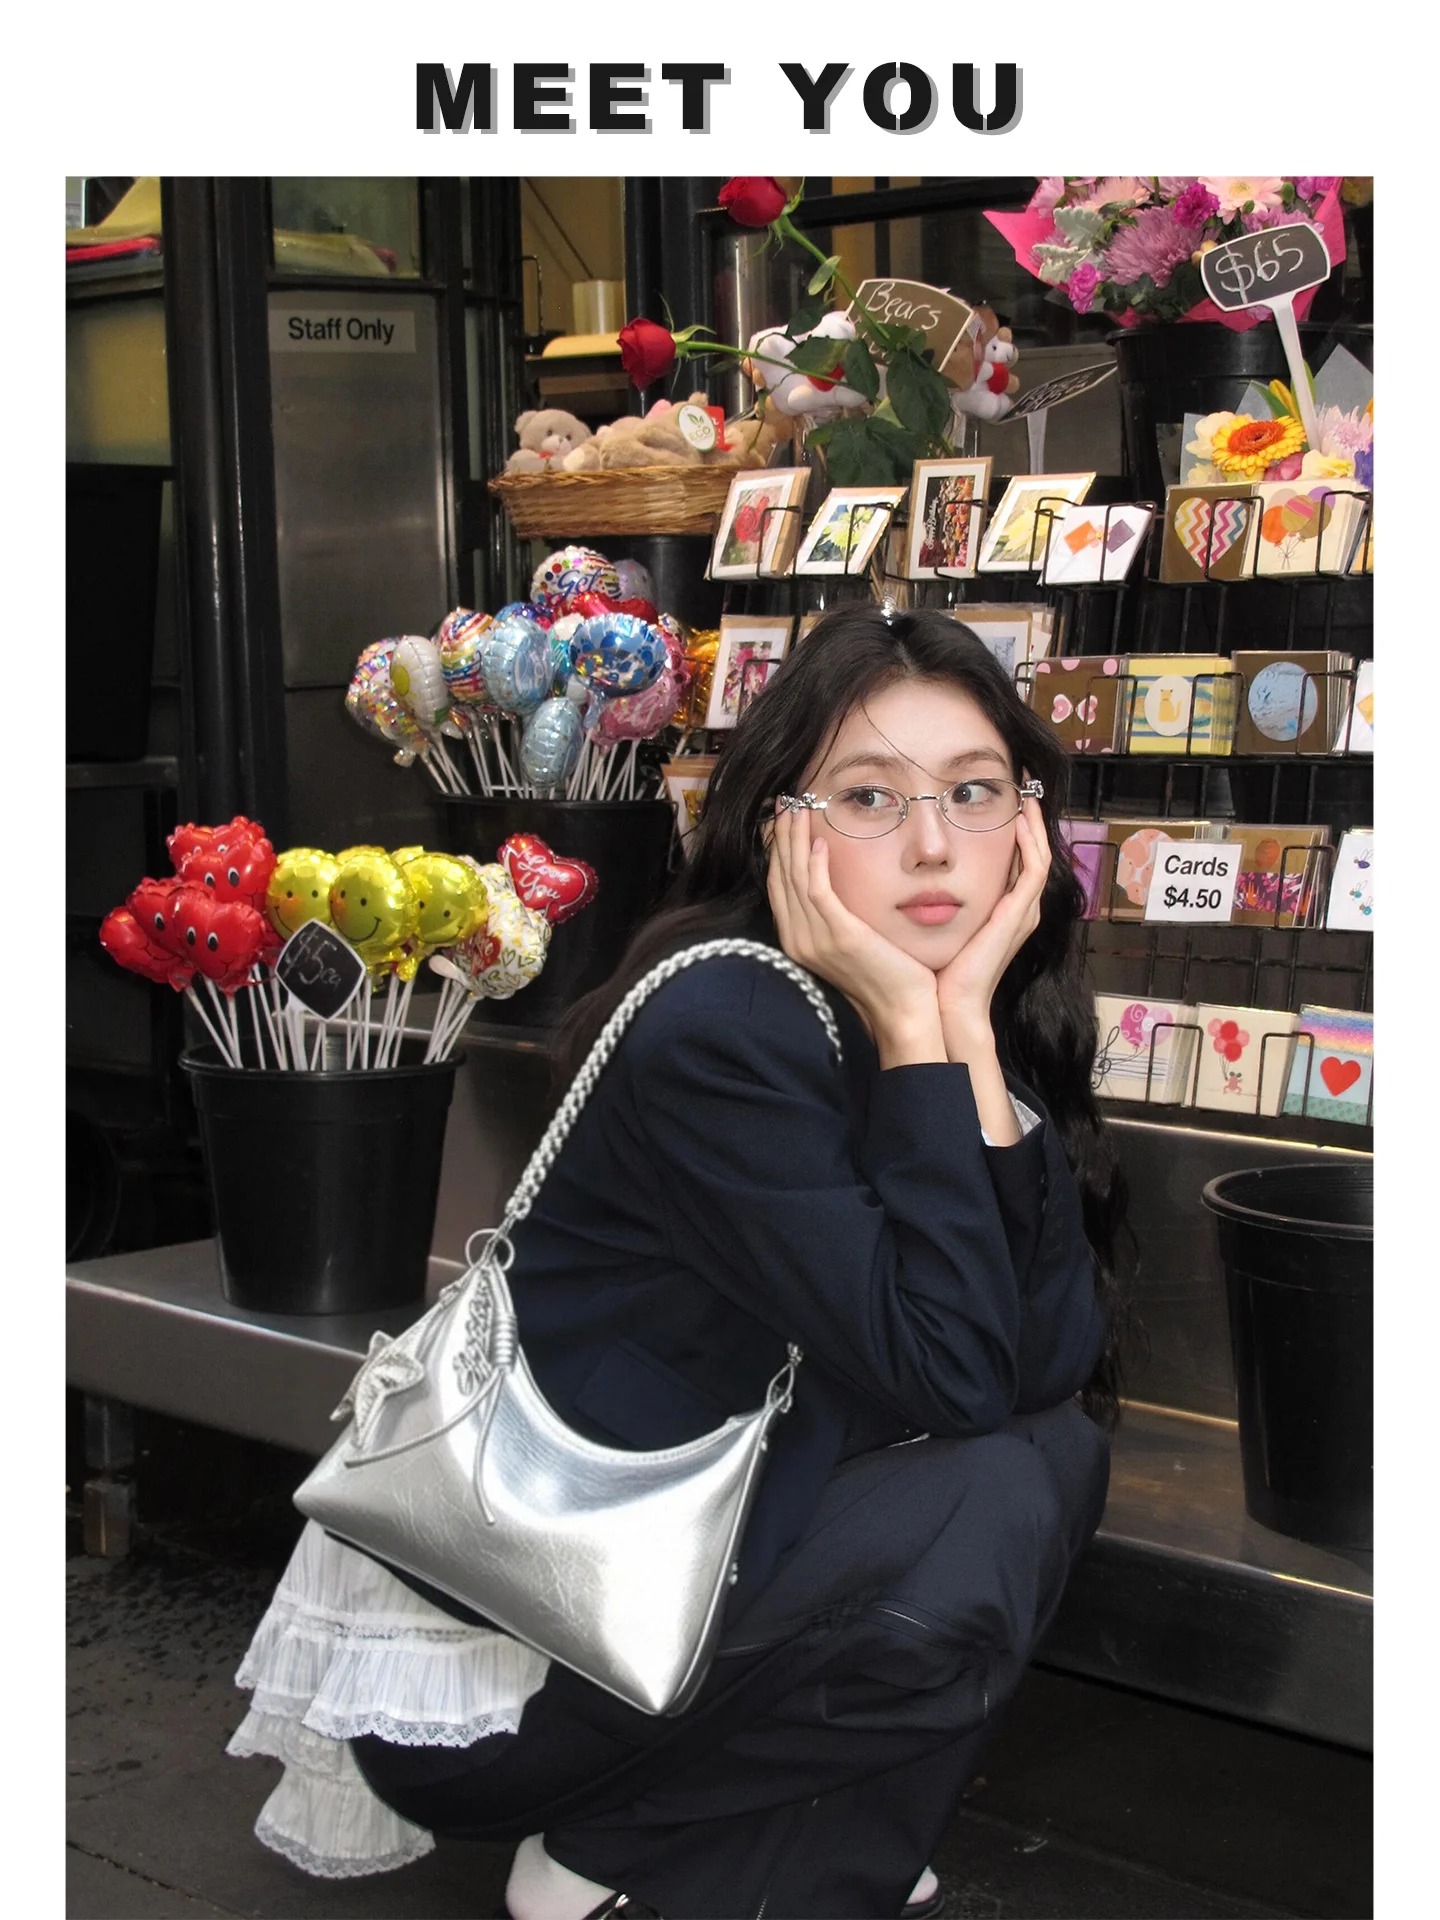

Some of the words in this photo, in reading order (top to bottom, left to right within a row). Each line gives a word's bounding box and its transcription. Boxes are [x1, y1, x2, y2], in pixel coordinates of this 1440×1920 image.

[1215, 232, 1304, 304] $65
[864, 282, 942, 331] Bears
[288, 317, 341, 340] Staff
[346, 317, 395, 346] Only
[517, 850, 571, 883] Love
[1164, 854, 1229, 877] Cards
[520, 872, 561, 901] You
[1163, 884, 1222, 909] $4.50
